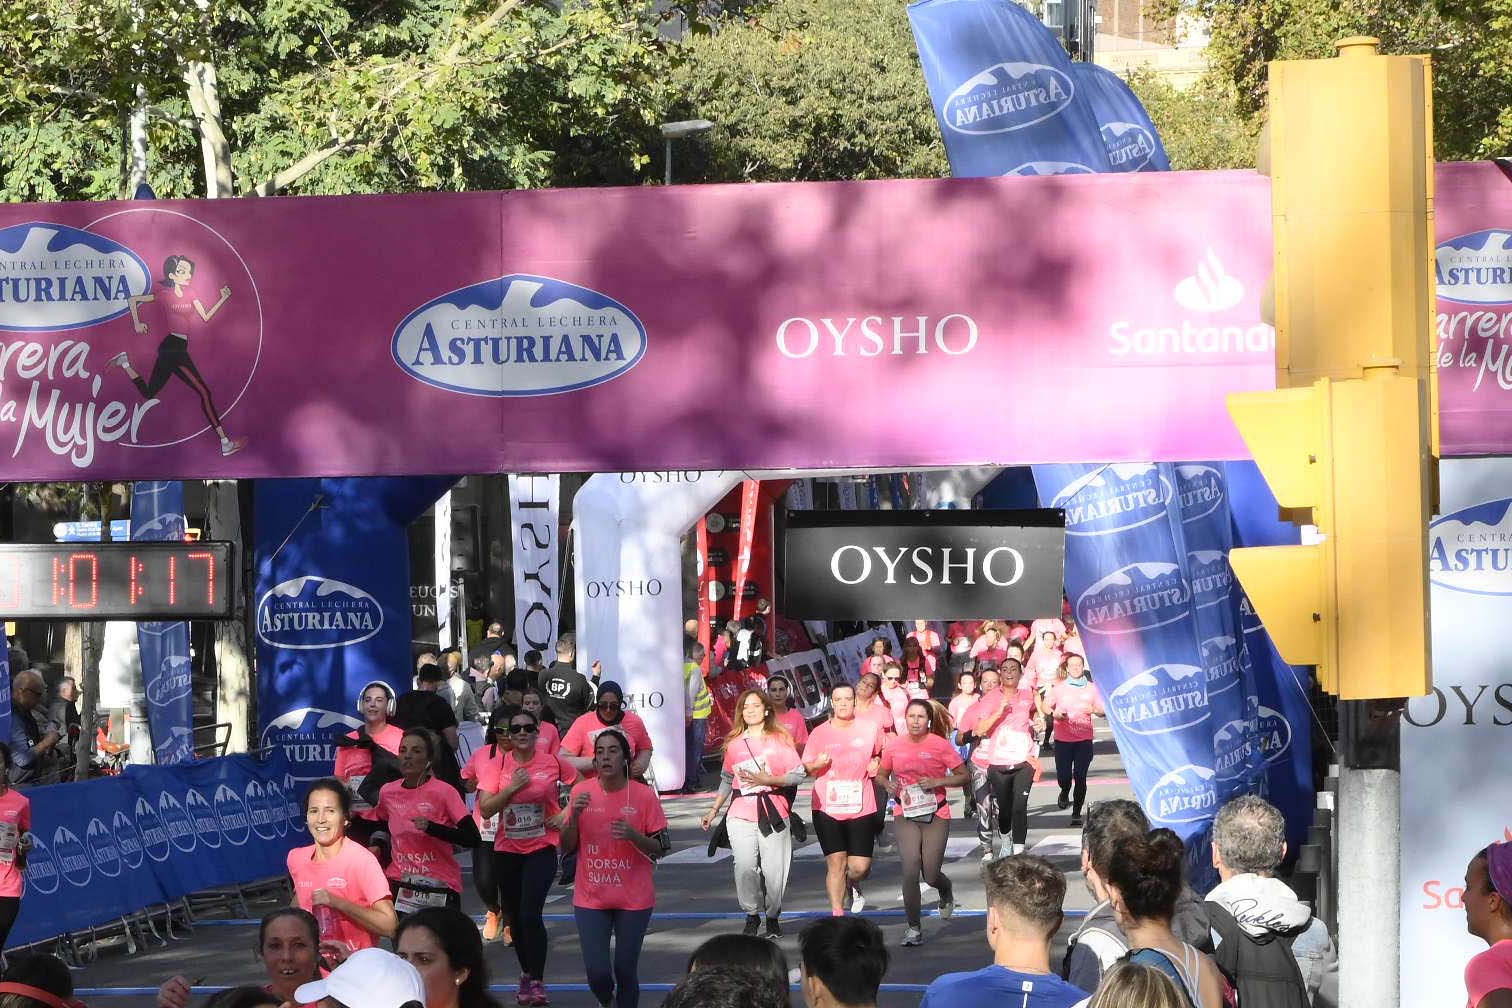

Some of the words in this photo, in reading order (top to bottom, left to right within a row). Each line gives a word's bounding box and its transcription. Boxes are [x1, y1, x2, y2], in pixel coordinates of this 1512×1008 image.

[53, 258, 126, 270] LECHERA
[450, 318, 529, 331] CENTRAL
[536, 315, 619, 329] LECHERA
[775, 313, 980, 359] OYSHO
[1436, 311, 1512, 340] arrer
[410, 322, 627, 367] ASTURIANA
[1459, 340, 1477, 367] la
[12, 372, 161, 468] Mujer
[830, 544, 1025, 587] OYSHO
[586, 577, 663, 599] OYSHO
[261, 606, 375, 634] ASTURIANA
[588, 858, 632, 871] DORSAL
[589, 872, 622, 884] SUMA
